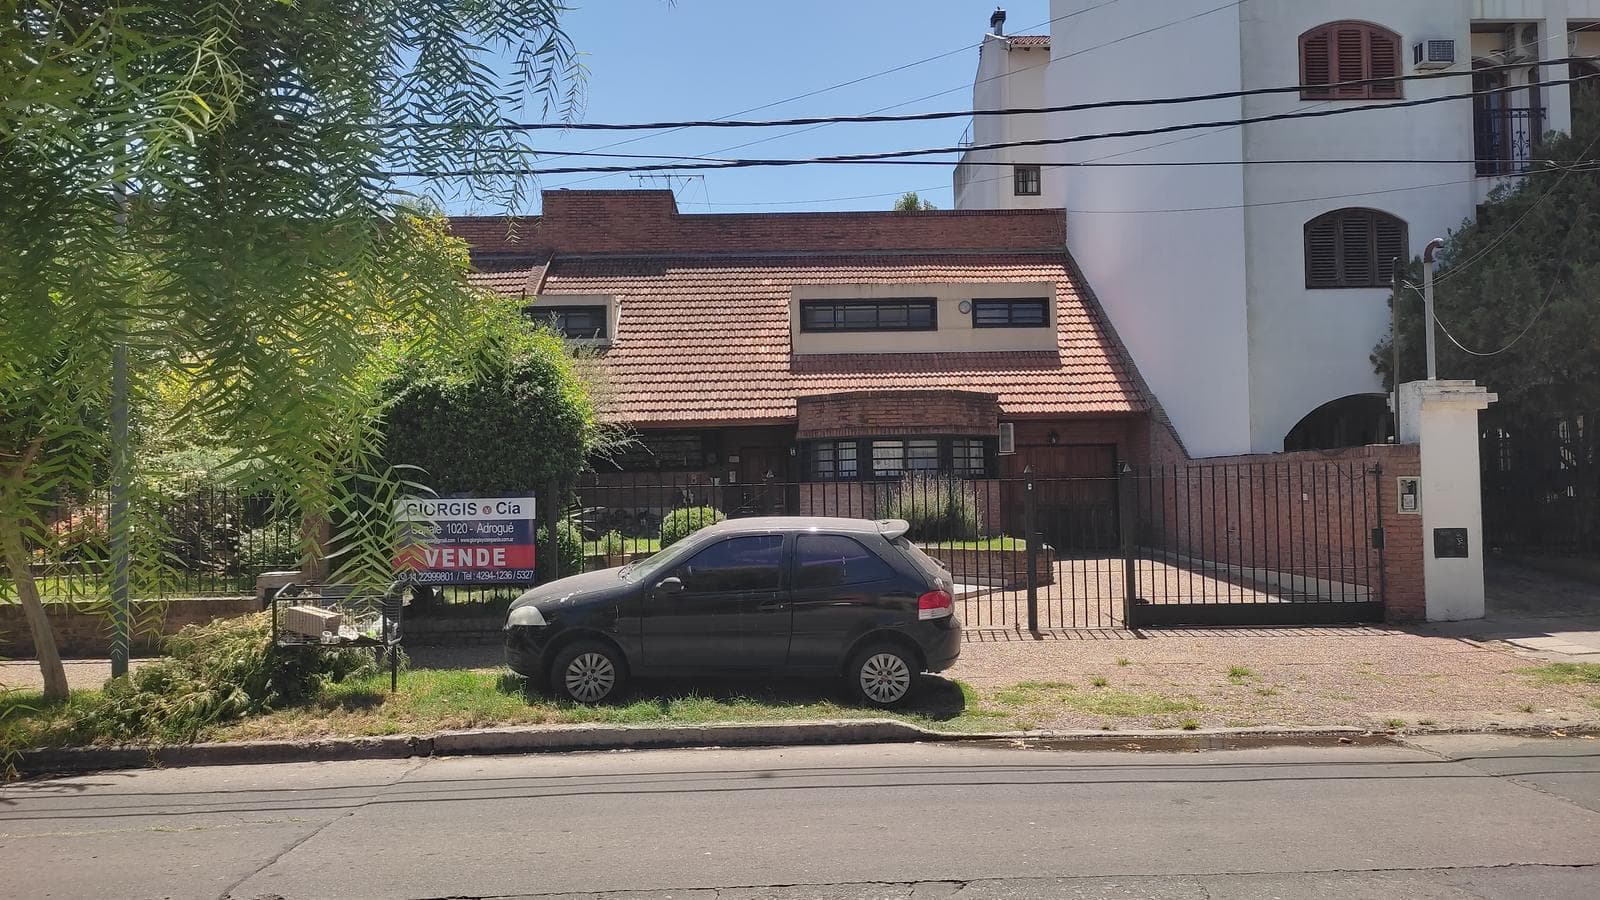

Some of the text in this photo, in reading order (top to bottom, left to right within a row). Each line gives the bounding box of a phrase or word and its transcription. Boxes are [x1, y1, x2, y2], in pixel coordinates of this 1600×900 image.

[407, 502, 477, 516] GIORGIS
[496, 501, 521, 515] Cía
[447, 523, 468, 534] 1020
[477, 522, 514, 535] Adrogué
[424, 547, 506, 567] VENDE
